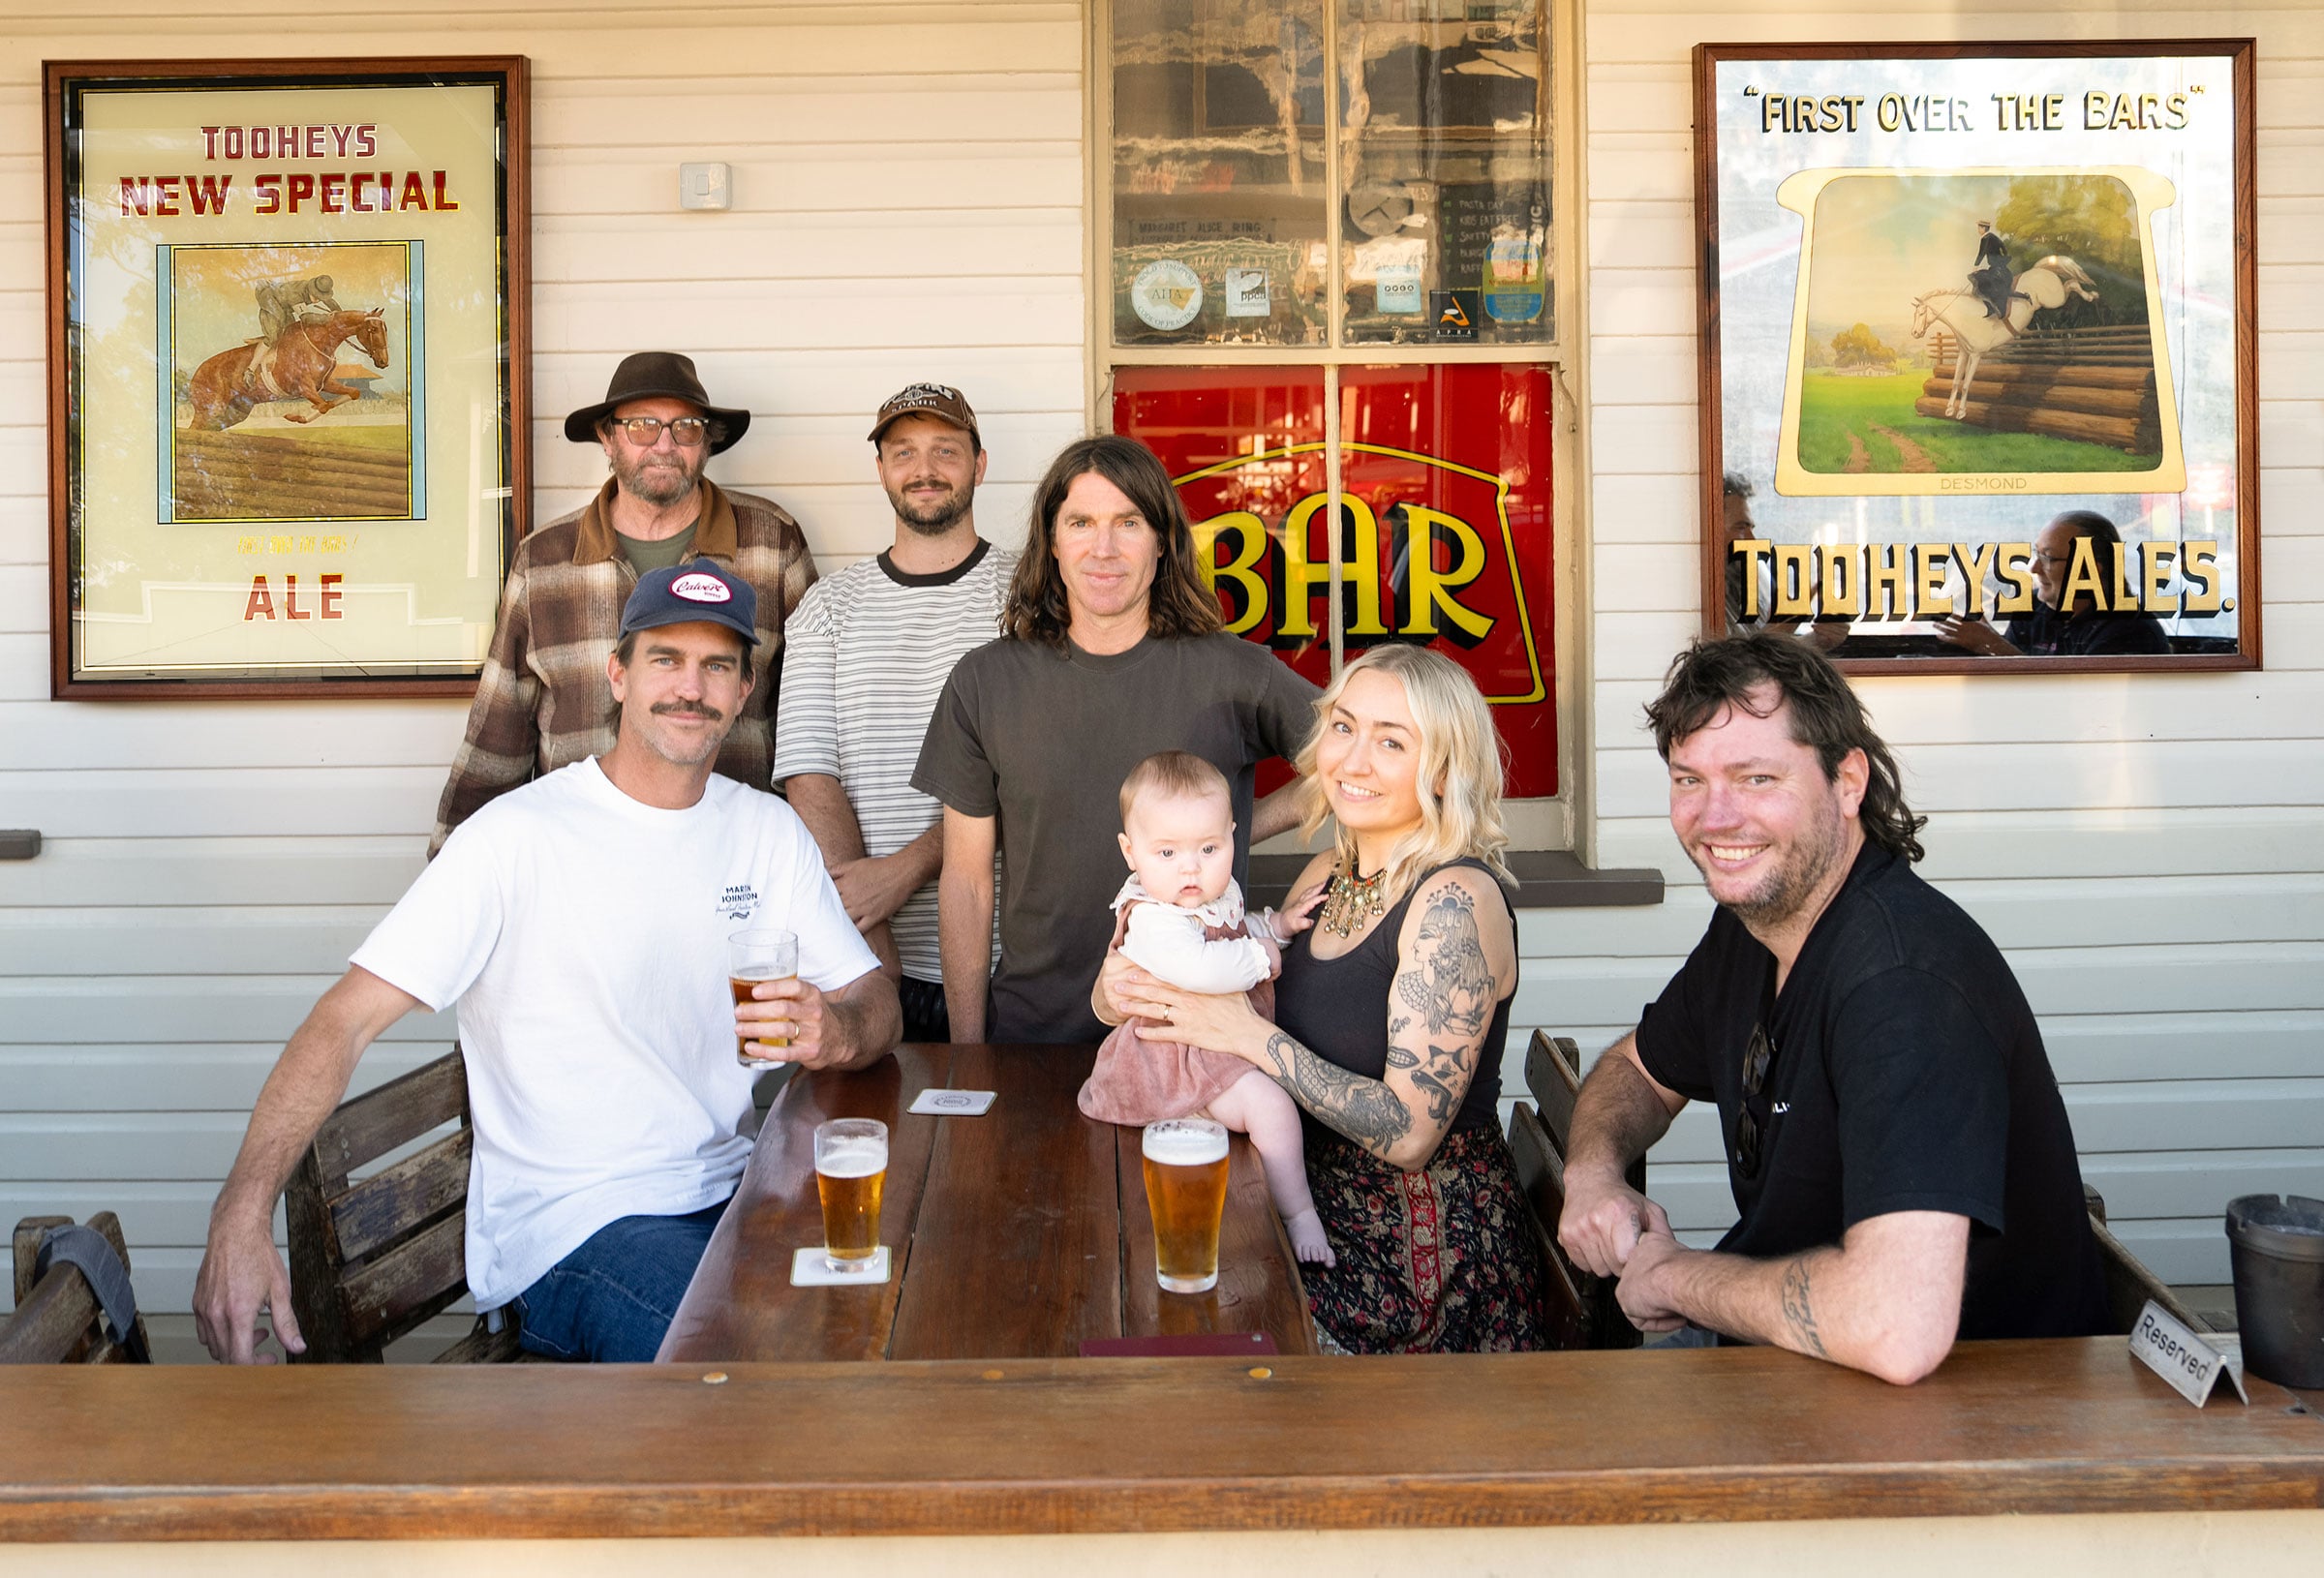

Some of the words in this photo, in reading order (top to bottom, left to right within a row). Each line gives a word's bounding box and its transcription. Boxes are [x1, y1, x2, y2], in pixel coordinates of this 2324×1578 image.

[1878, 92, 1973, 133] OVER
[1992, 91, 2064, 133] THE
[200, 124, 379, 161] TOOHEYS
[119, 174, 231, 218] NEW
[254, 170, 461, 215] SPECIAL
[1151, 288, 1182, 300] AHA
[1240, 291, 1267, 302] ppca
[1940, 477, 2028, 492] DESMOND
[1192, 490, 1499, 650] BAR
[1728, 540, 2034, 622] TOOHEYS
[2056, 536, 2237, 621] ALES.
[242, 572, 346, 622] ALE
[2139, 1314, 2211, 1381] Reserved
